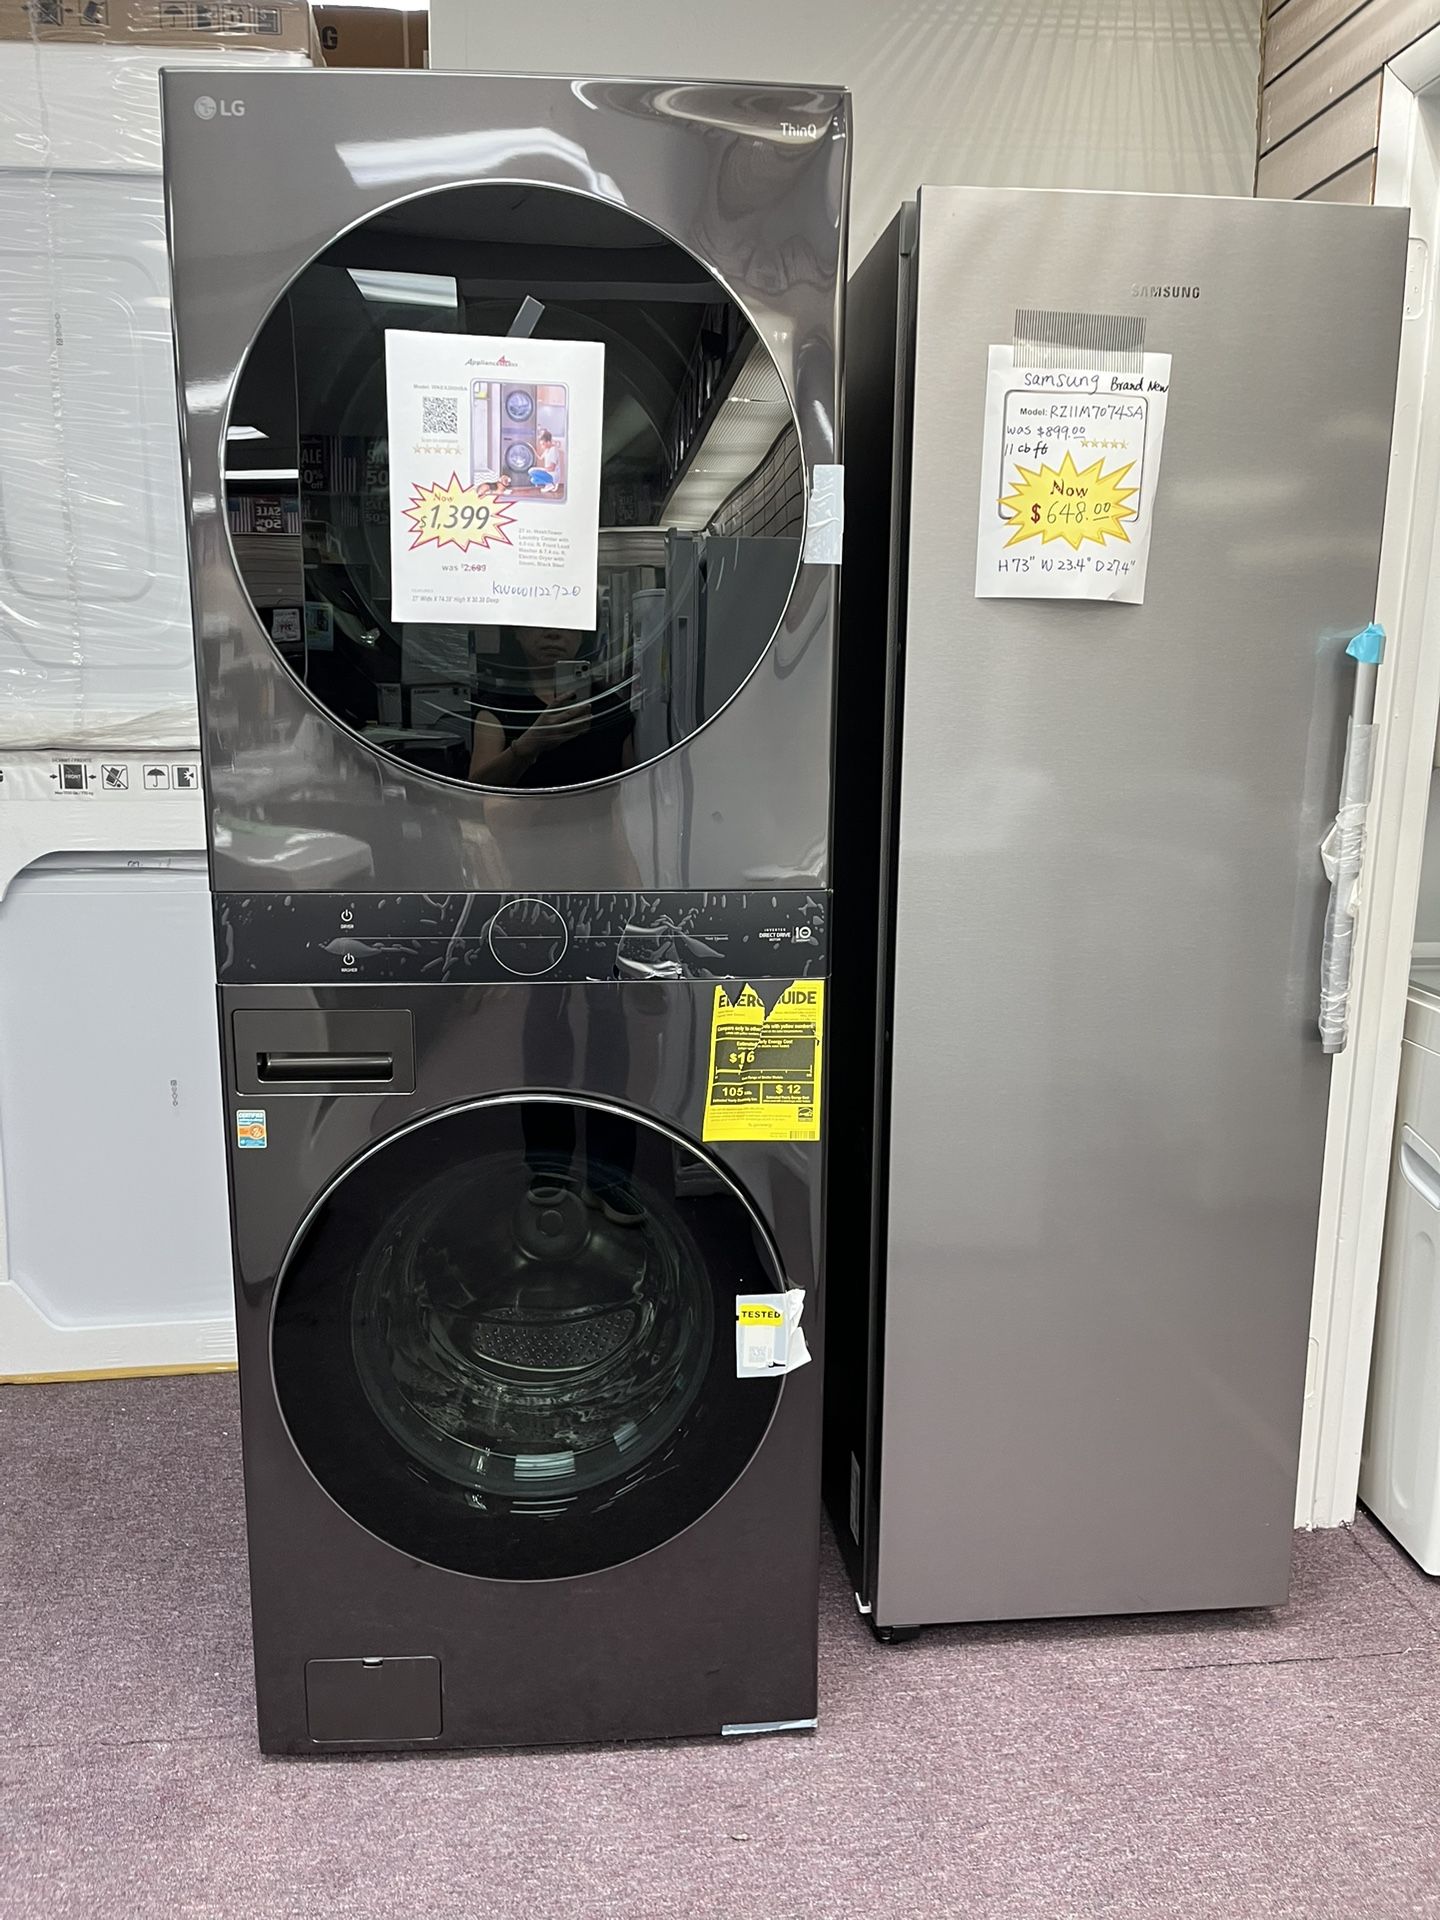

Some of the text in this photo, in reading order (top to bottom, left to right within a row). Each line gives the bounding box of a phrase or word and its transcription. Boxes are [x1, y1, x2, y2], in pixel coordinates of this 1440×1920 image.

[220, 100, 246, 116] LG
[780, 122, 816, 139] ThinQ
[1131, 286, 1200, 298] SAMSUNG
[1110, 377, 1144, 392] Brand
[1147, 382, 1168, 392] New
[1020, 408, 1048, 416] Model:
[1007, 426, 1032, 435] was
[1033, 441, 1048, 458] ft
[1050, 479, 1088, 498] Now
[433, 494, 454, 502] Now
[420, 504, 490, 530] $1,399
[778, 991, 816, 1004] UIDE
[729, 1051, 755, 1064] $16
[723, 1087, 744, 1096] 105
